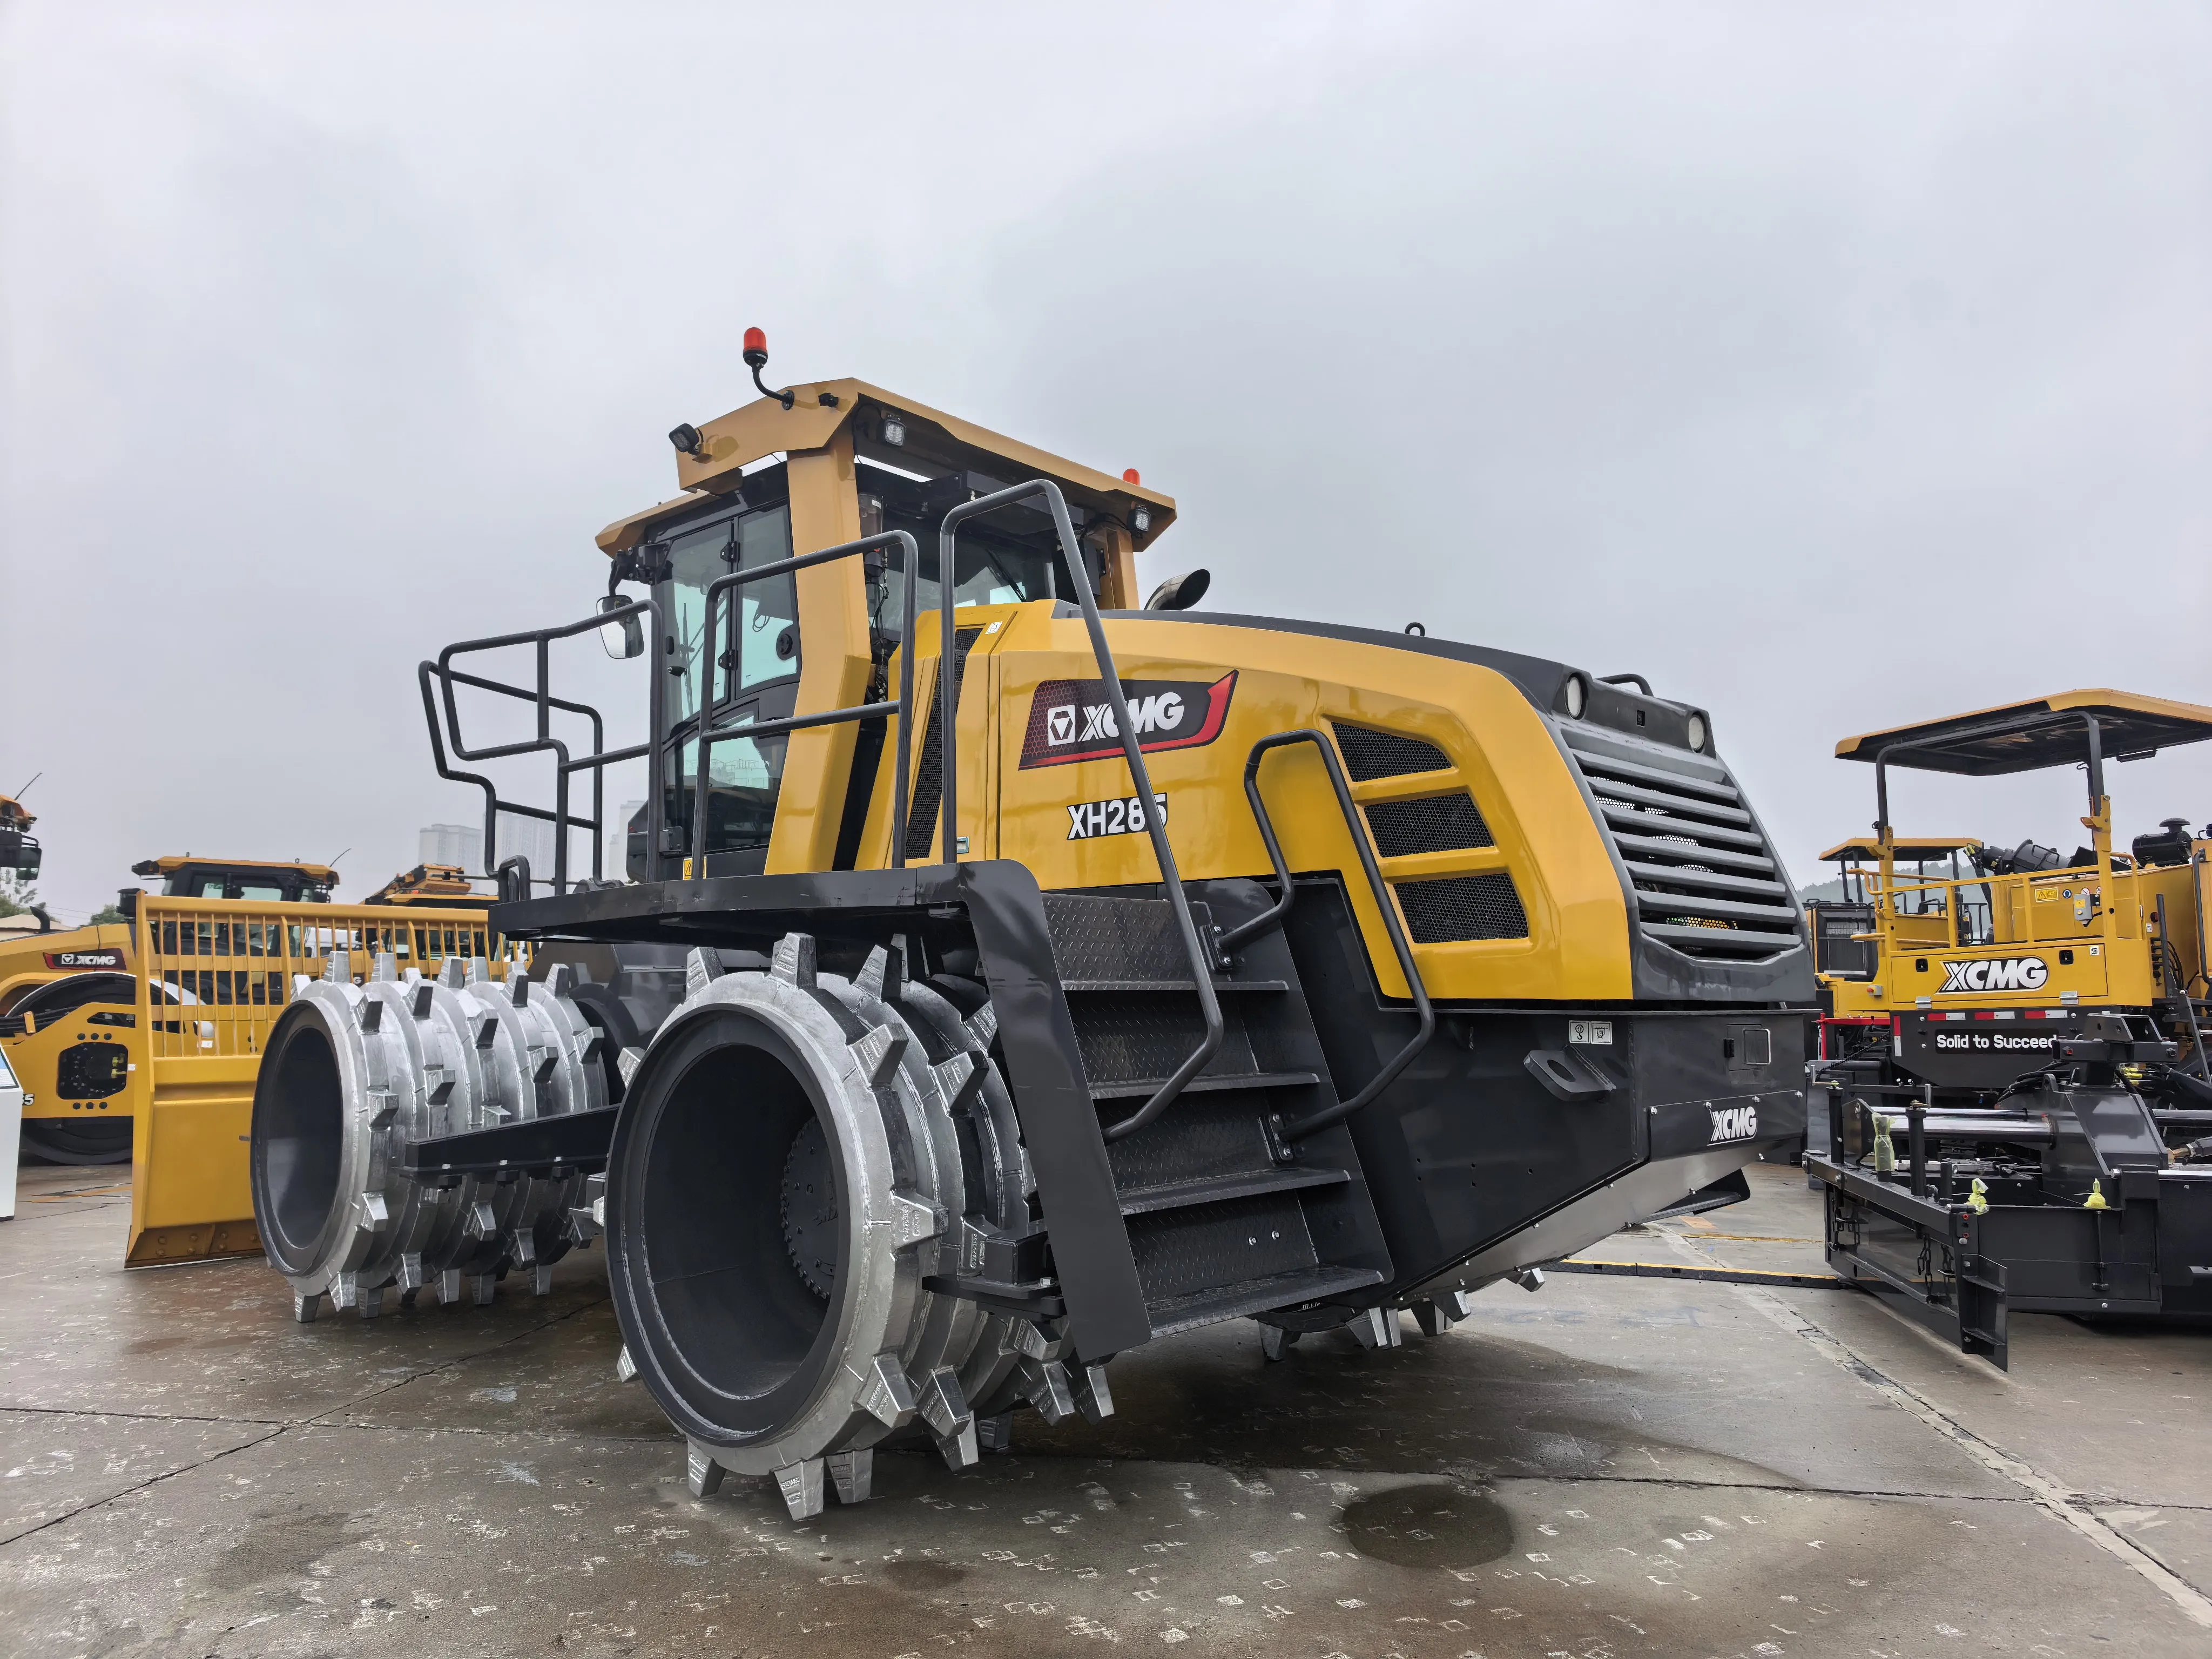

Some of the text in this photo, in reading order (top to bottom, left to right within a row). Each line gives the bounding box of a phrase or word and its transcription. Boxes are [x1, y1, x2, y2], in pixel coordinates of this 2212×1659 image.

[1078, 692, 1184, 742] XCMG
[73, 955, 117, 966] XCMG
[1941, 957, 2047, 990] XCMG
[1937, 1035, 1969, 1048] Solid
[1973, 1035, 1990, 1048] to
[1710, 1106, 1757, 1141] XCMG
